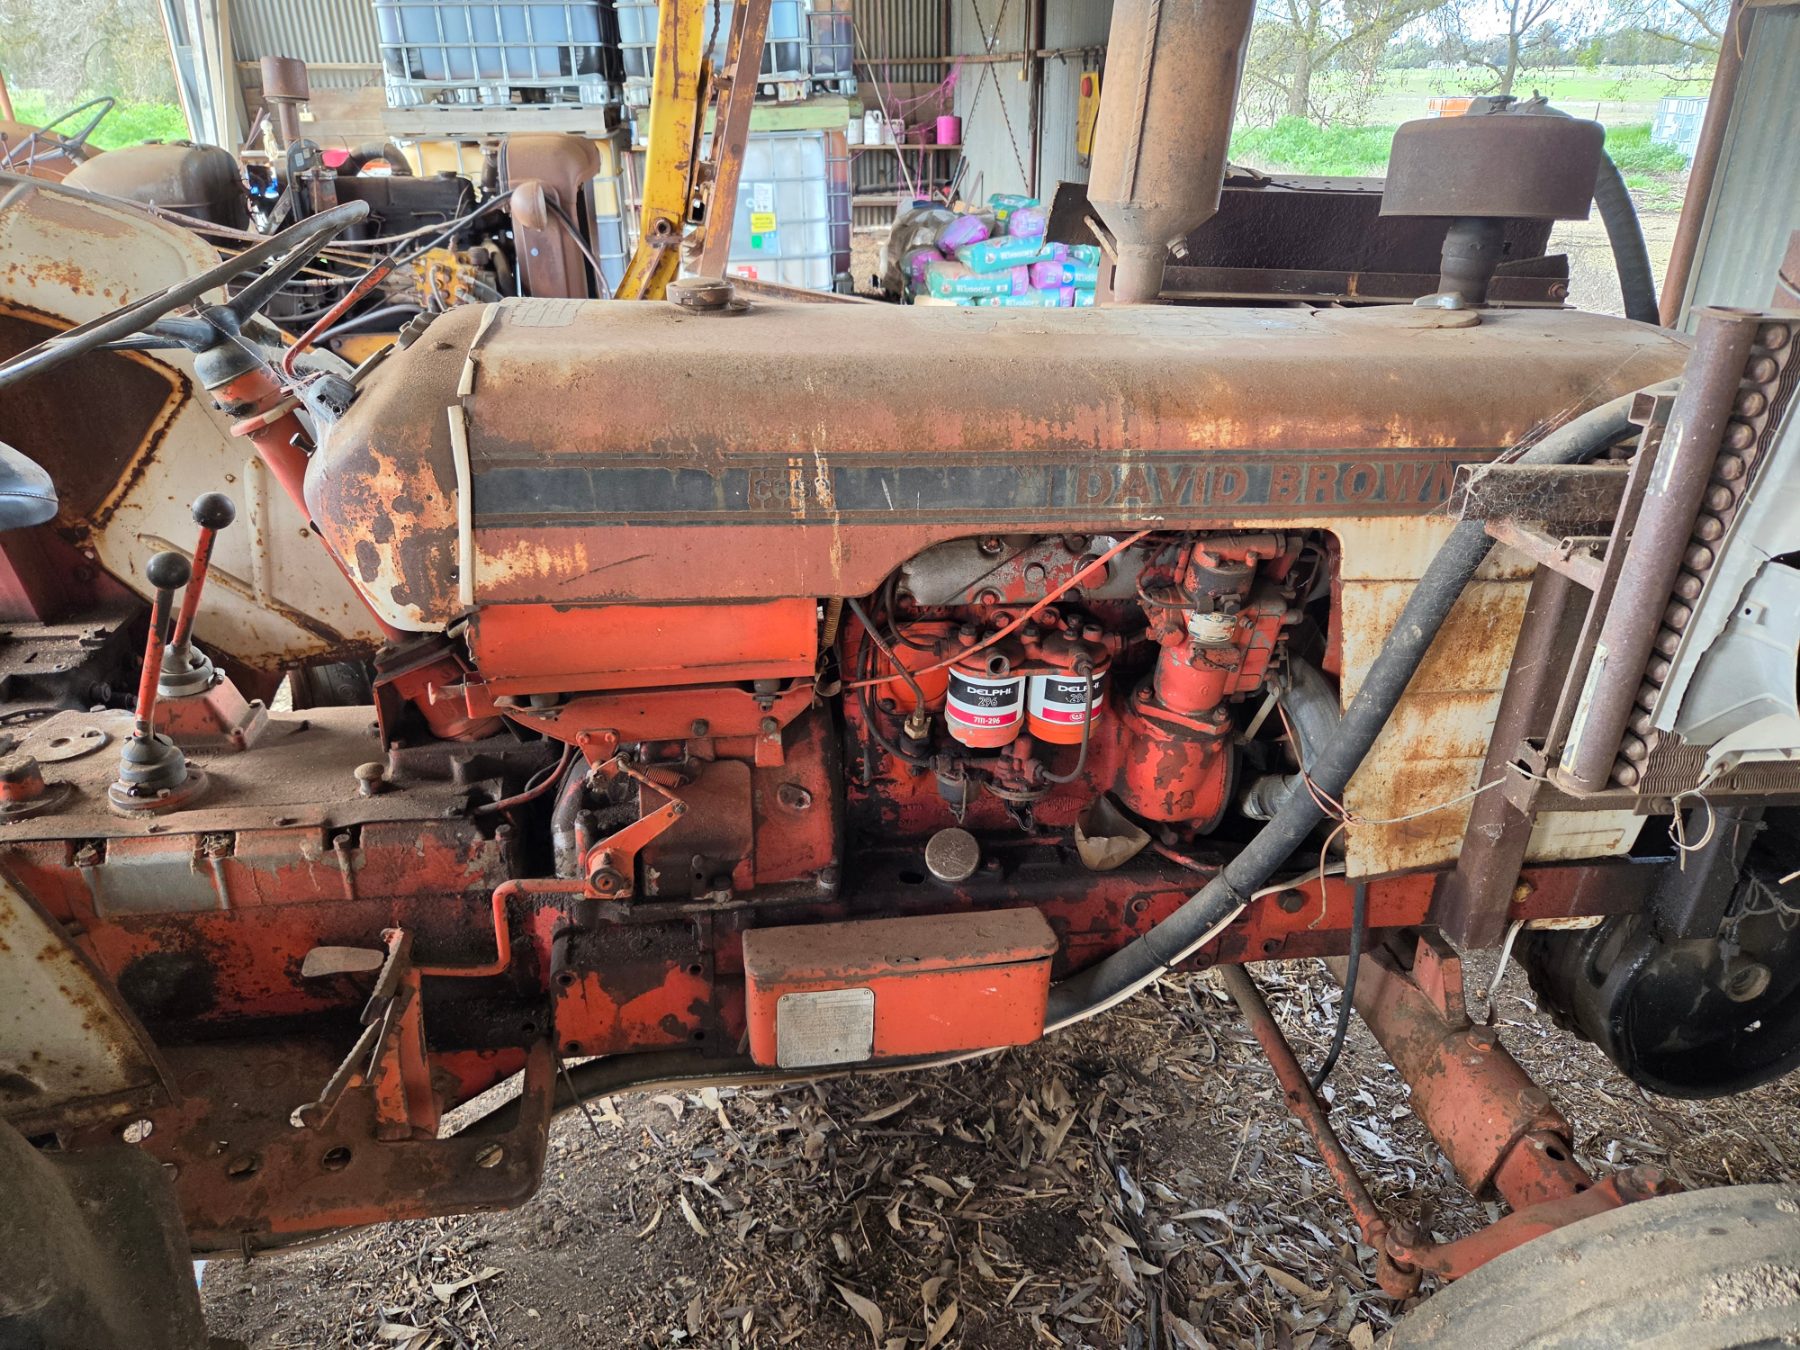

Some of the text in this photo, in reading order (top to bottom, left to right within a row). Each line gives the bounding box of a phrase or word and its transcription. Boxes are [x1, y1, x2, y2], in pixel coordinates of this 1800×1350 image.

[1075, 463, 1453, 504] DAVID BROWN
[966, 686, 1011, 697] DELPHI
[977, 696, 998, 707] 296
[973, 716, 1001, 725] 7111-296
